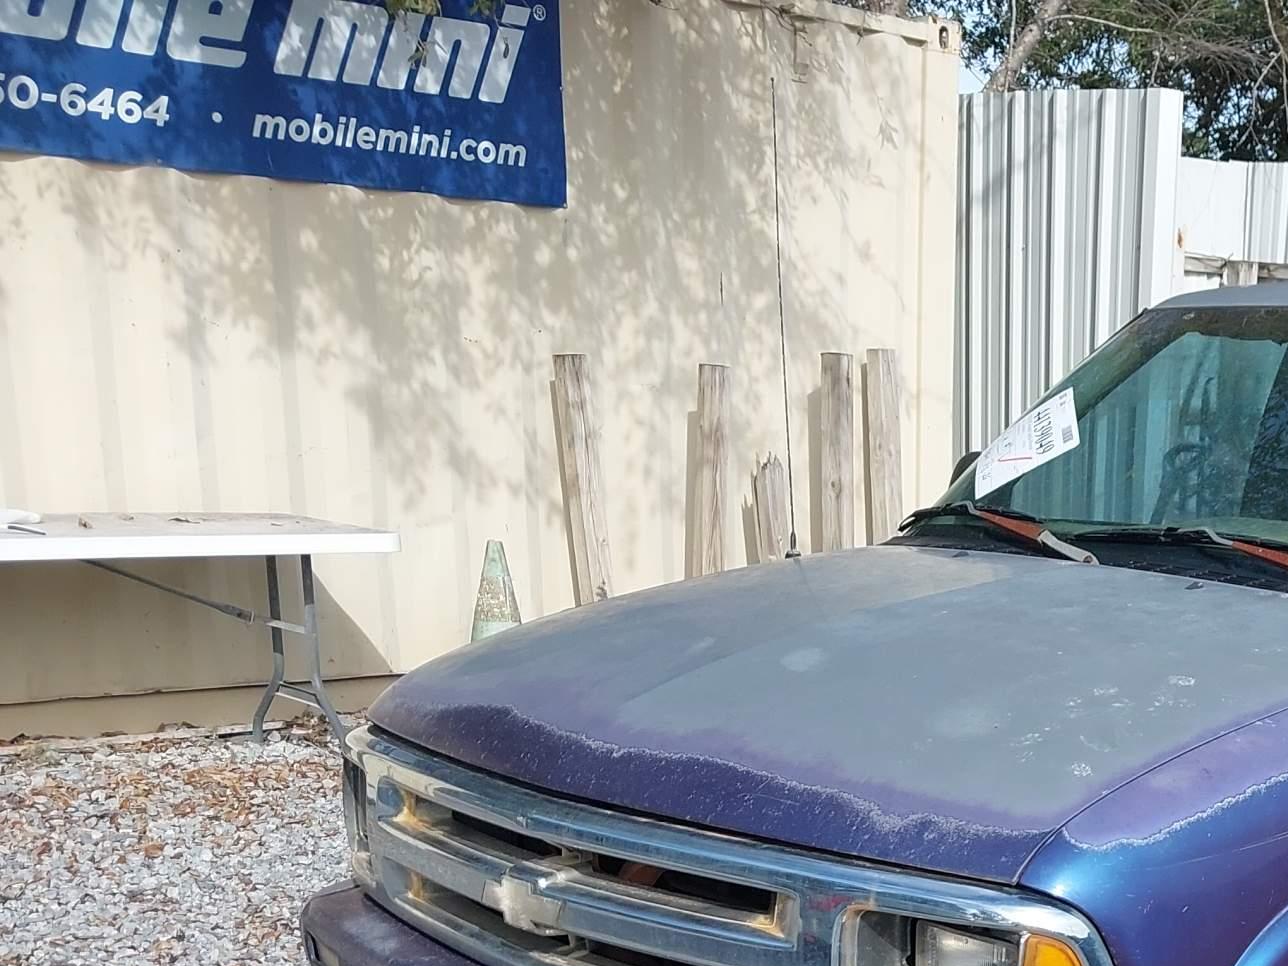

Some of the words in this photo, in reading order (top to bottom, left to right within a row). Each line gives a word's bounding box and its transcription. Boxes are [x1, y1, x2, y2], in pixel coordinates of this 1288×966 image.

[273, 0, 532, 104] mini
[0, 72, 170, 128] 0-6464
[252, 112, 528, 168] mobilemini.com
